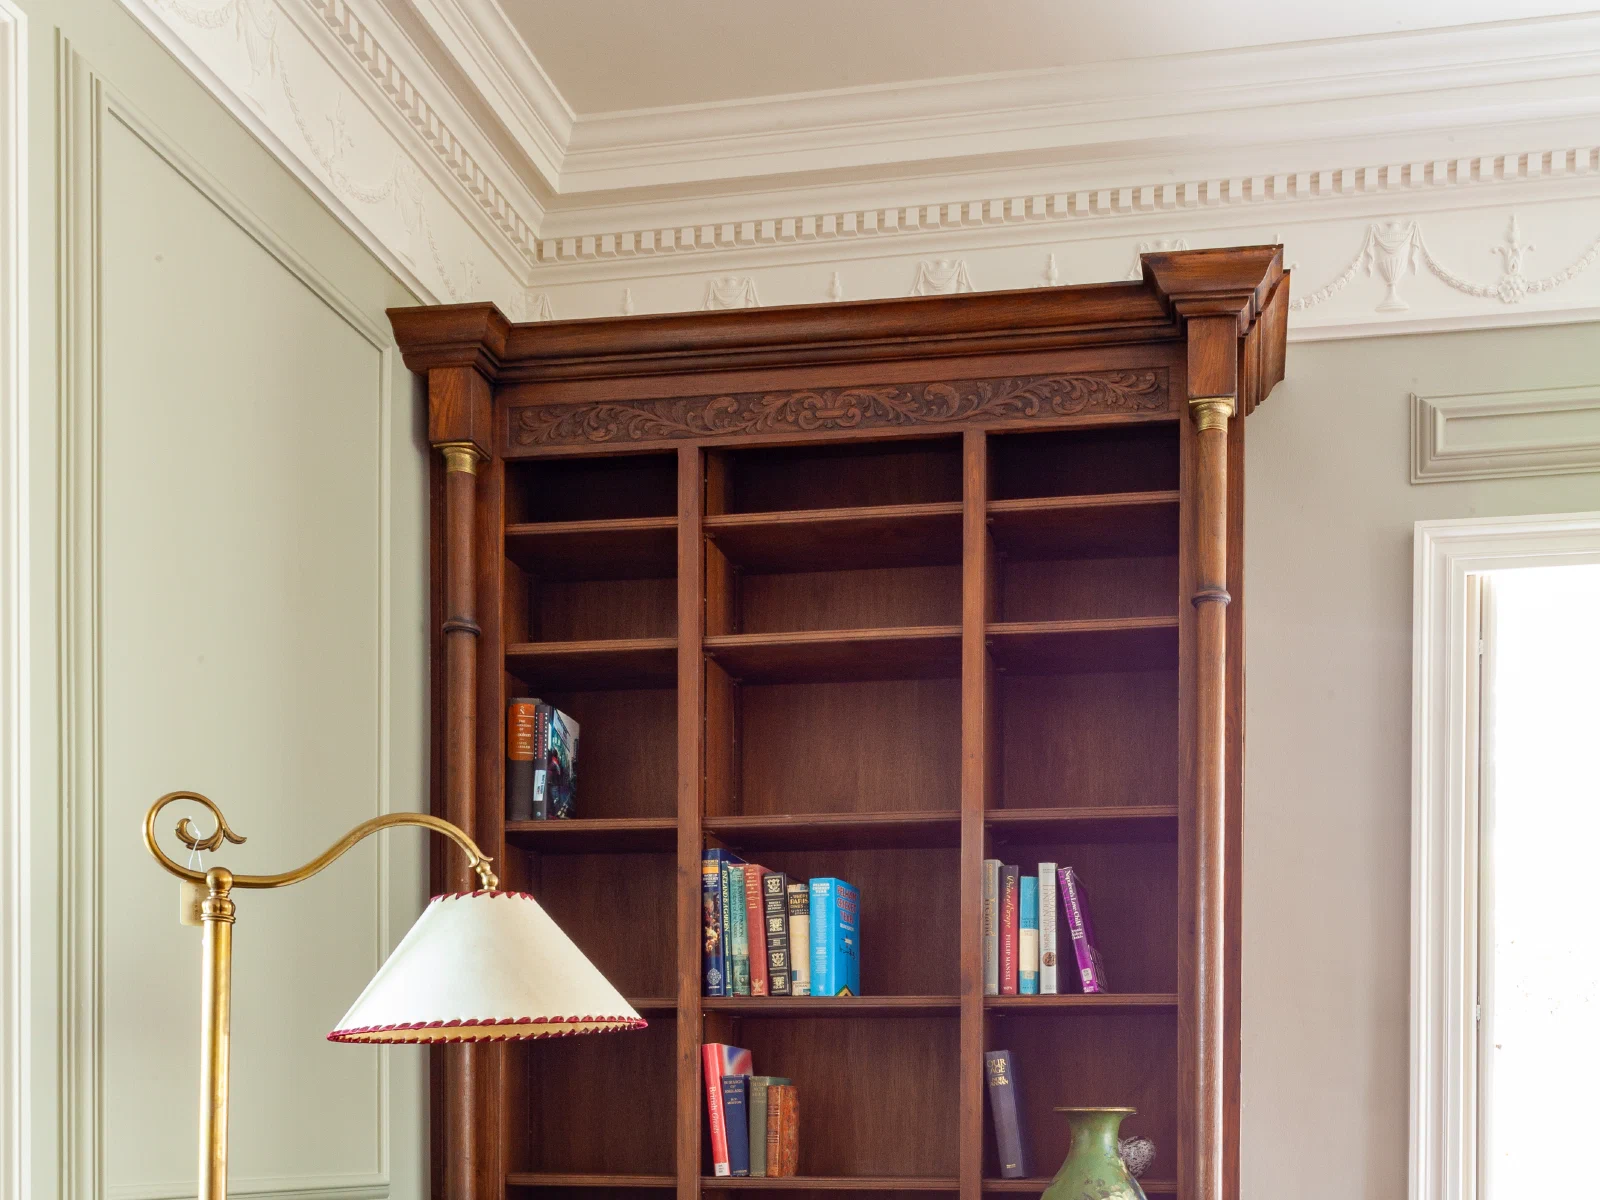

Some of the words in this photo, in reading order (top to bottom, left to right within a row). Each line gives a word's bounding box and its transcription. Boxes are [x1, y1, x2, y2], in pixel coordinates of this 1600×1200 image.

[837, 884, 857, 902] PELHAM
[1005, 875, 1014, 898] Prince
[836, 897, 857, 913] CRICKET
[1065, 870, 1076, 897] Napoleon's
[1073, 911, 1082, 927] Child
[840, 910, 854, 925] YEAR
[1004, 905, 1015, 929] Europe
[987, 1058, 1006, 1067] OUR
[990, 1065, 1005, 1074] AGE
[709, 1086, 718, 1110] British
